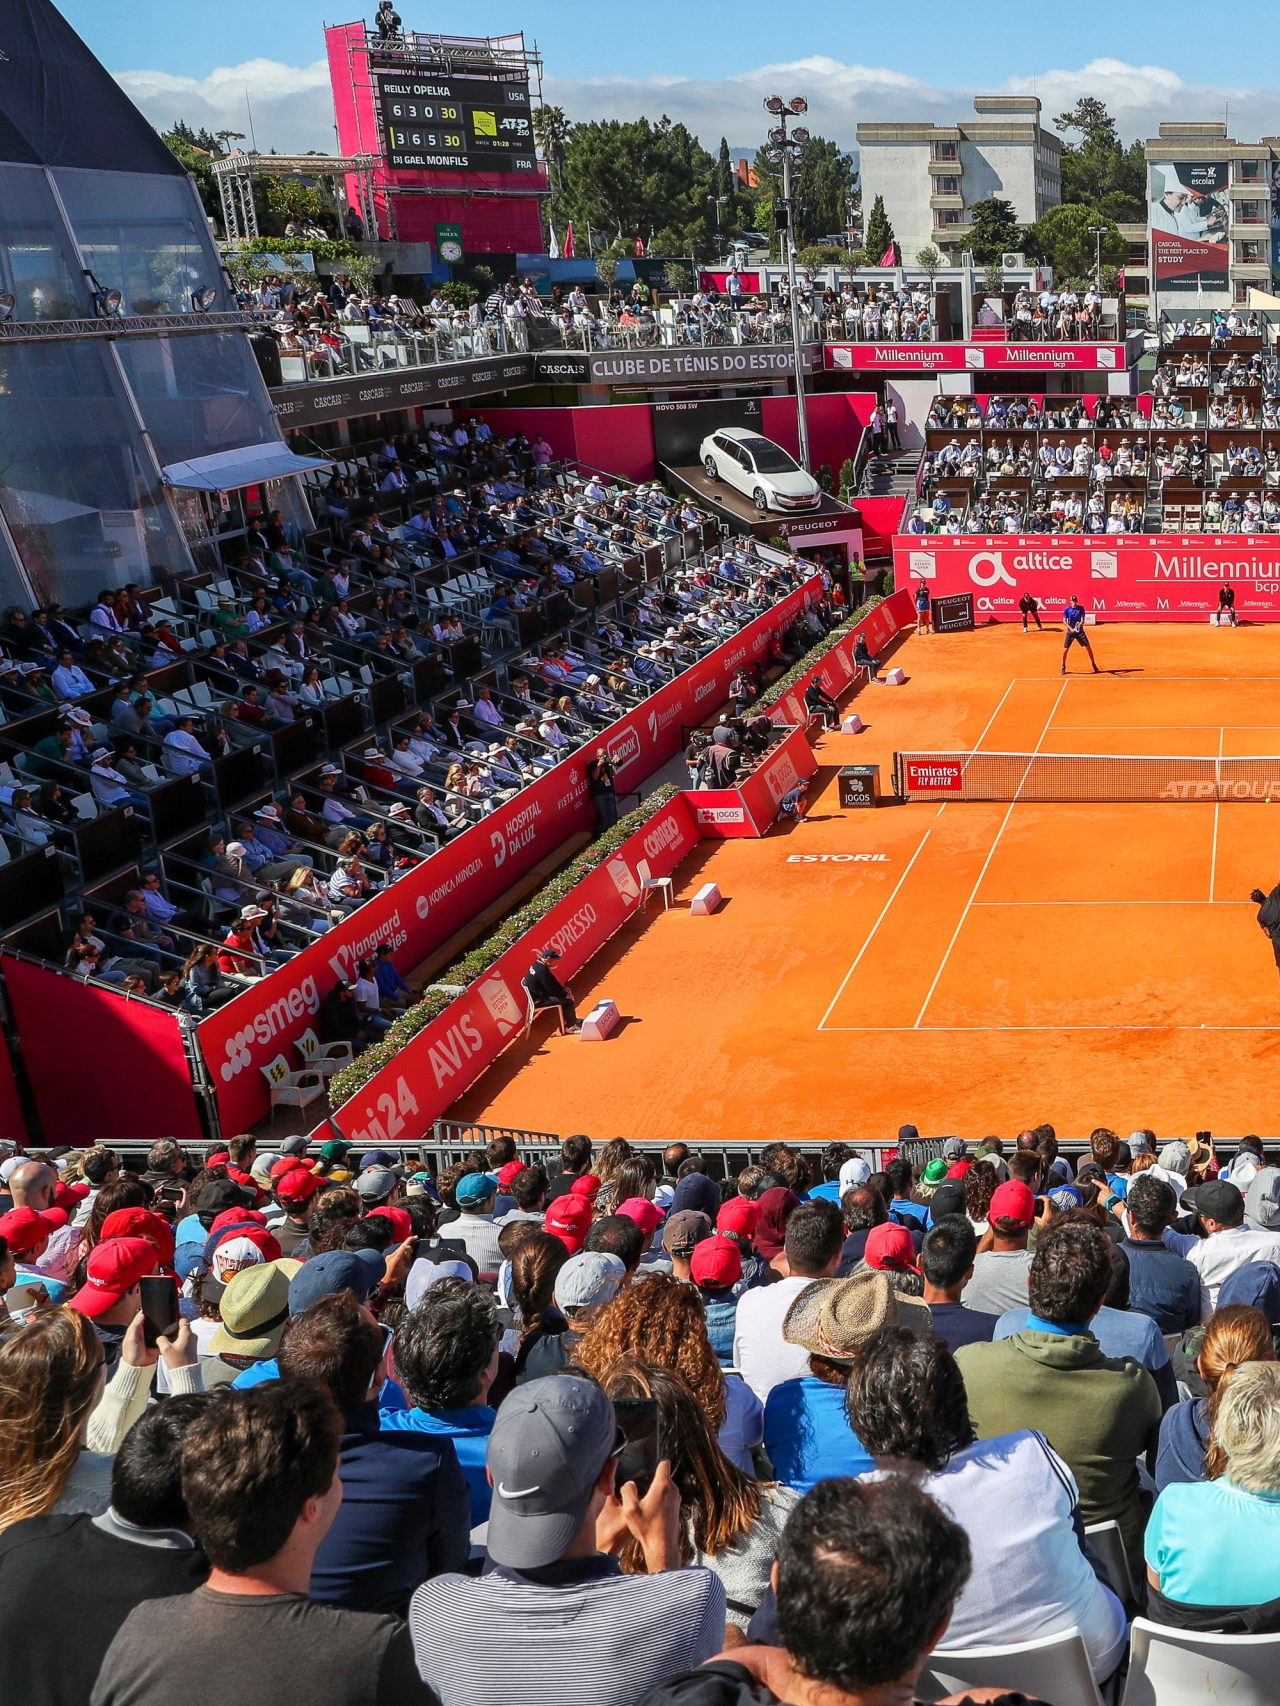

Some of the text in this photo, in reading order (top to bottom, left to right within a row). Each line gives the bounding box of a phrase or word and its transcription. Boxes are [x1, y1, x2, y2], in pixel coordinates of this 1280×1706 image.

[384, 84, 450, 97] REILLY OPELKA
[508, 92, 525, 101] USA
[393, 105, 457, 119] 6 3 0 30
[500, 118, 529, 130] ATP
[397, 134, 460, 147] 3 6 5 30
[393, 155, 468, 166] [3] GAEL MONFILS
[516, 160, 532, 169] FRA
[874, 346, 944, 361] Millennium
[1005, 347, 1075, 361] Millennium
[539, 364, 585, 374] CASCAIS
[592, 353, 810, 377] CLUBE DE TÉNIS DO ESTORL
[922, 360, 935, 368] bcp
[1054, 360, 1066, 368] bcp
[472, 371, 491, 382] CASCAIS
[503, 366, 521, 377] CASCAIS
[400, 381, 423, 394] CASCAIS
[437, 377, 459, 388] CASCAIS
[359, 388, 384, 401] CASCAIS
[314, 394, 342, 409] CASCAIS
[791, 520, 838, 532] PEUGEOT
[1013, 552, 1073, 570] altice
[1256, 581, 1279, 594] bcp
[937, 595, 971, 605] PEUGEOT
[992, 596, 1014, 605] altice
[1044, 596, 1067, 605] altice
[939, 620, 972, 630] PEUGEOT
[910, 765, 958, 777] Emirates
[918, 776, 952, 786] FLY BETTER
[1159, 781, 1216, 798] ATP
[558, 795, 573, 810] VISTA
[845, 794, 870, 804] JOGOS
[505, 801, 541, 835] HOSPITAL
[716, 810, 739, 820] JOGOS
[509, 824, 536, 856] DA LUZ
[786, 854, 891, 862] ESTORIL
[428, 857, 483, 907] KONICA MINOLTA
[348, 909, 400, 962] Vanguard
[492, 993, 509, 1010] ESTORIL
[497, 1001, 509, 1014] OPEN
[252, 974, 320, 1045] smeg
[427, 1014, 483, 1089] AVIS
